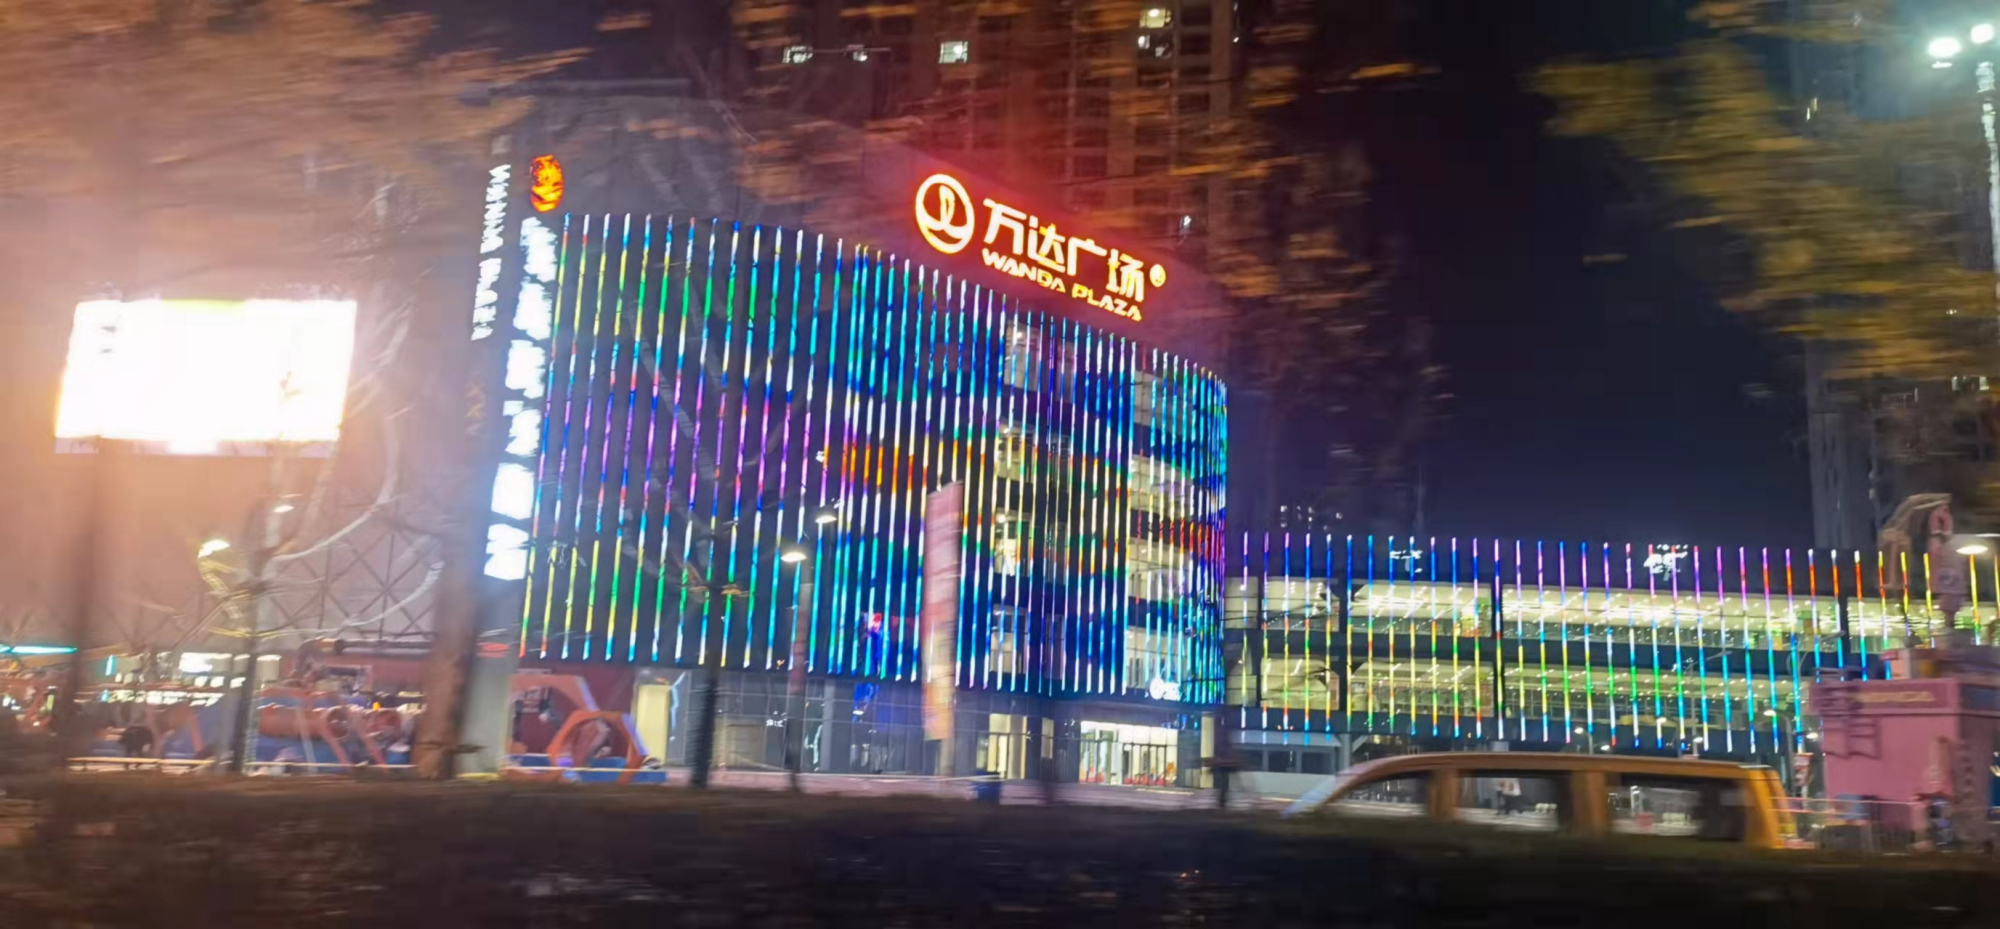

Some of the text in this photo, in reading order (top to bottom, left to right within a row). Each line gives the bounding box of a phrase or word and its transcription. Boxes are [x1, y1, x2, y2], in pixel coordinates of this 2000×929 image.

[982, 248, 1143, 321] WANDA PLAZA
[983, 198, 1144, 302] 万达广场
